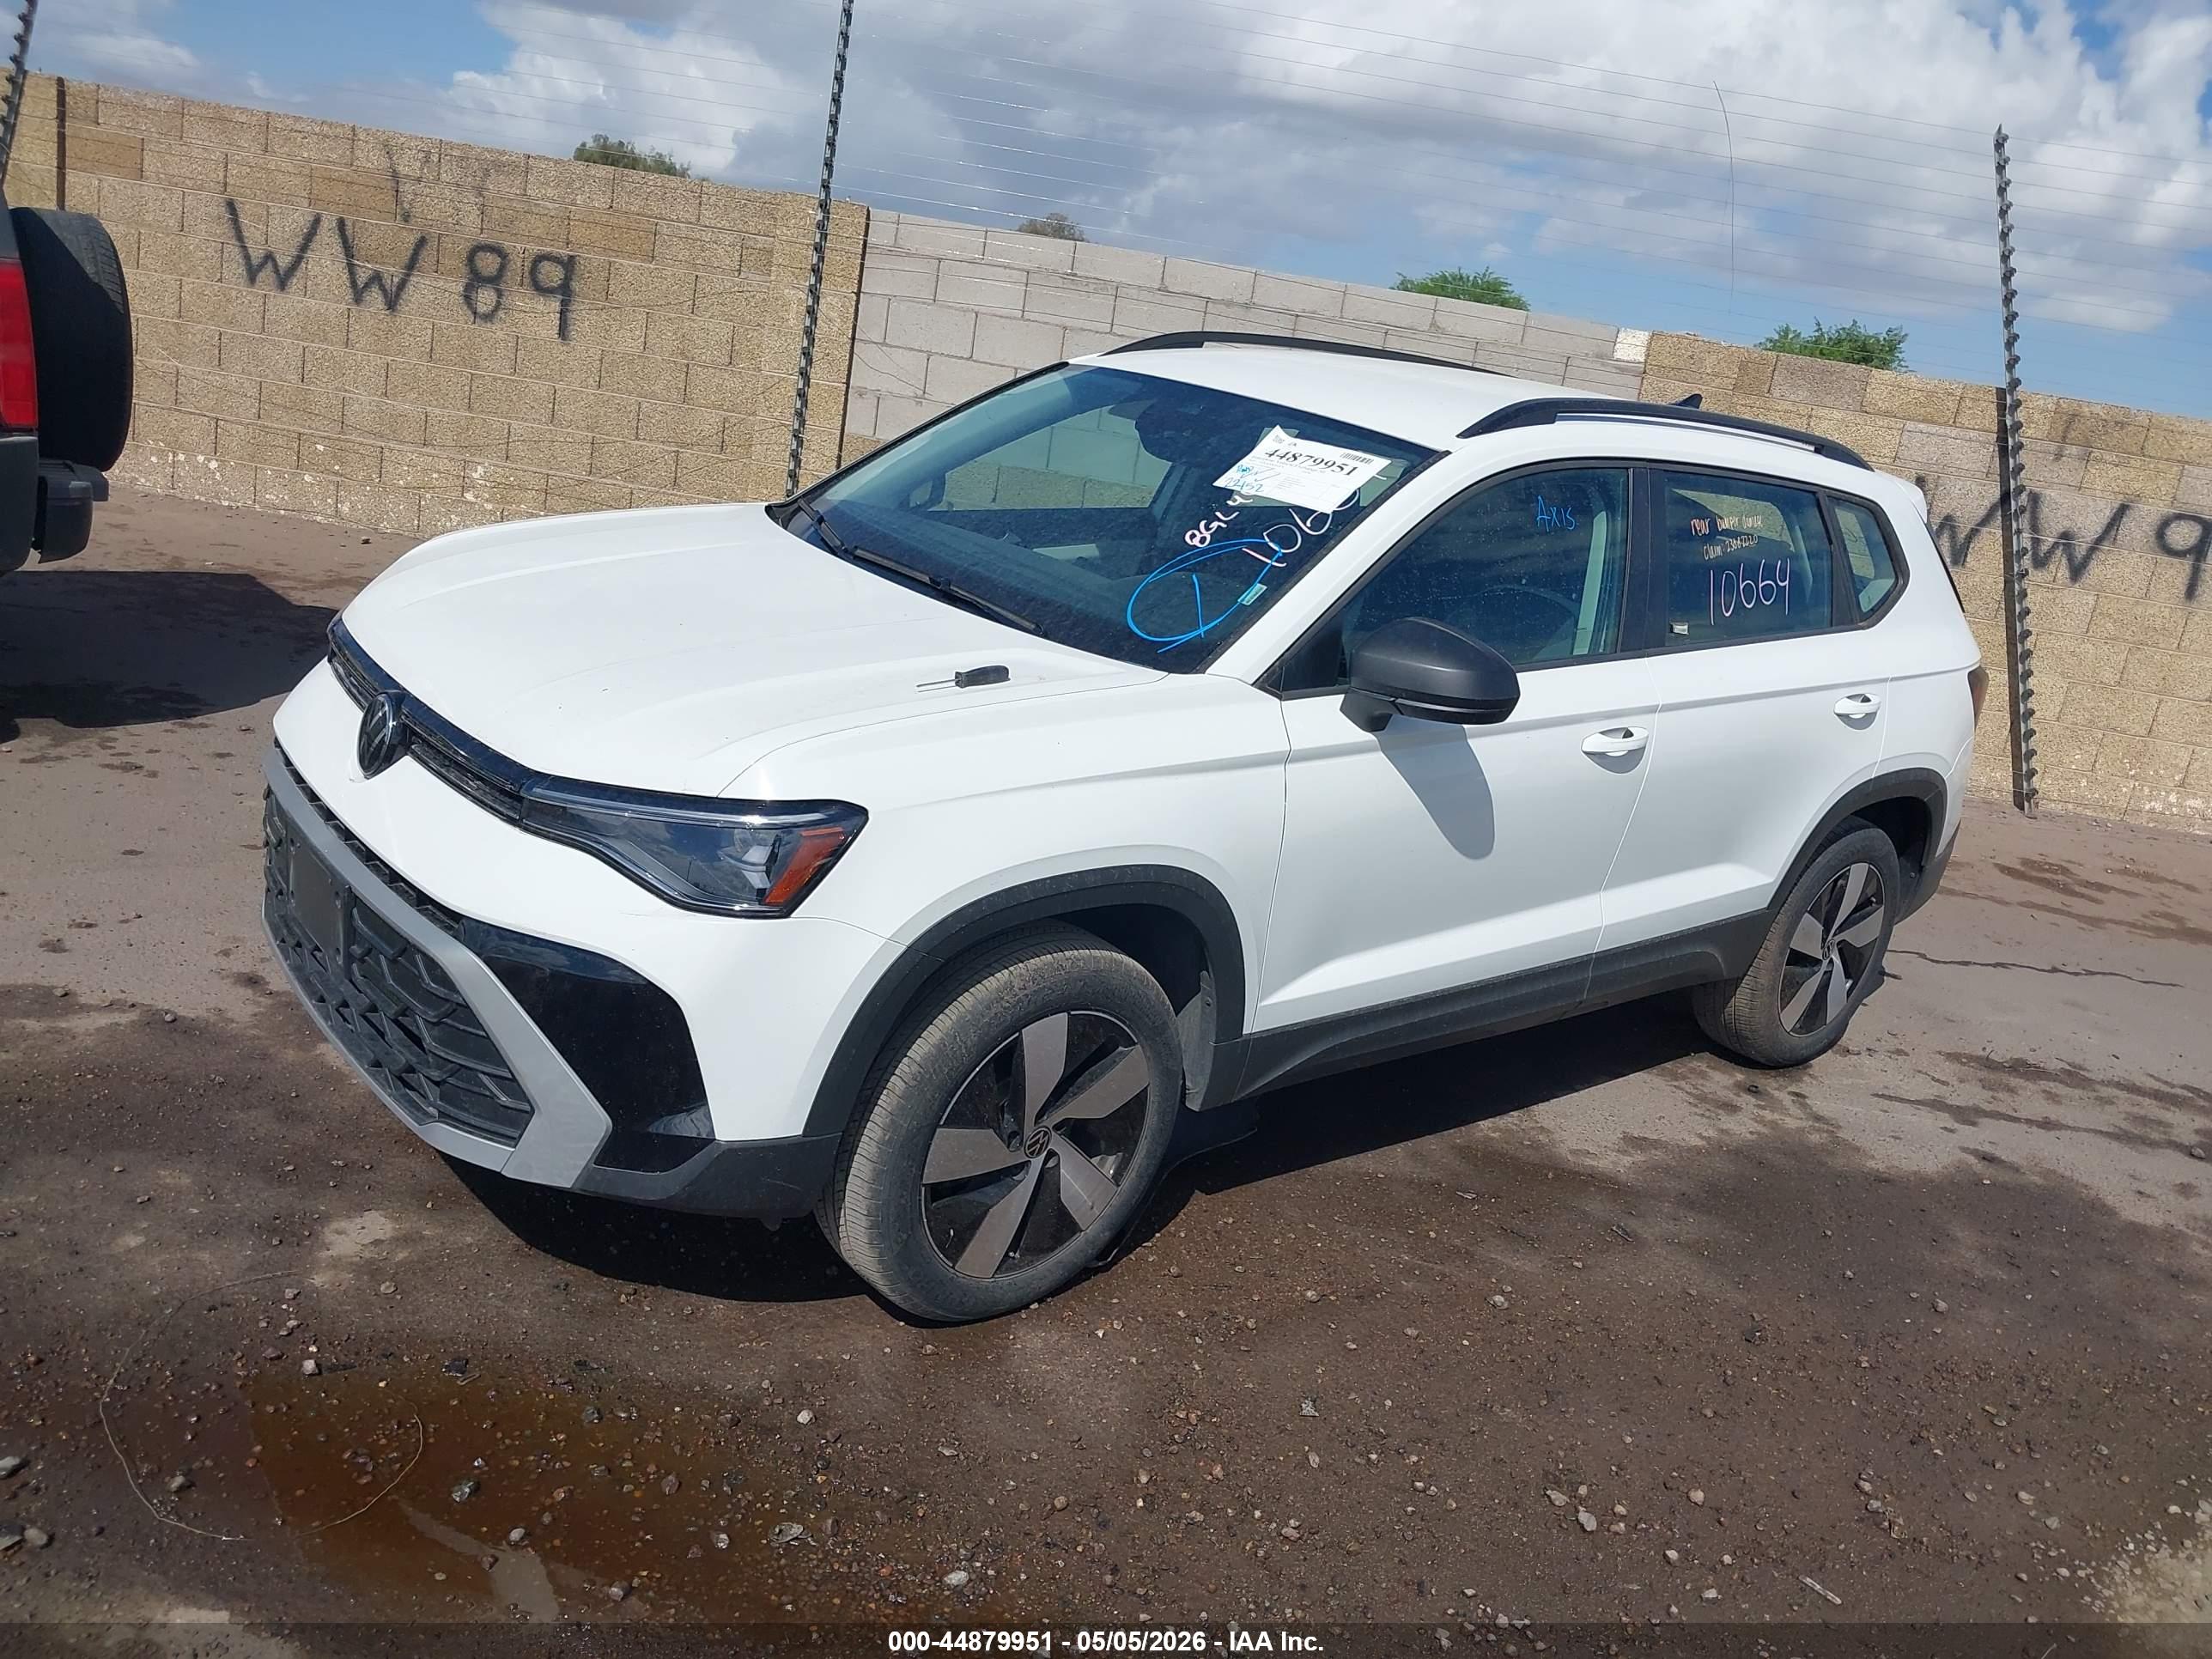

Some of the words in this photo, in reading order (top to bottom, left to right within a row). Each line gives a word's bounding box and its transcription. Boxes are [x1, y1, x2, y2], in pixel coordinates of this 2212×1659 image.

[463, 242, 576, 343] 89
[1264, 447, 1360, 477] 44879951
[1709, 557, 1790, 626] 10664
